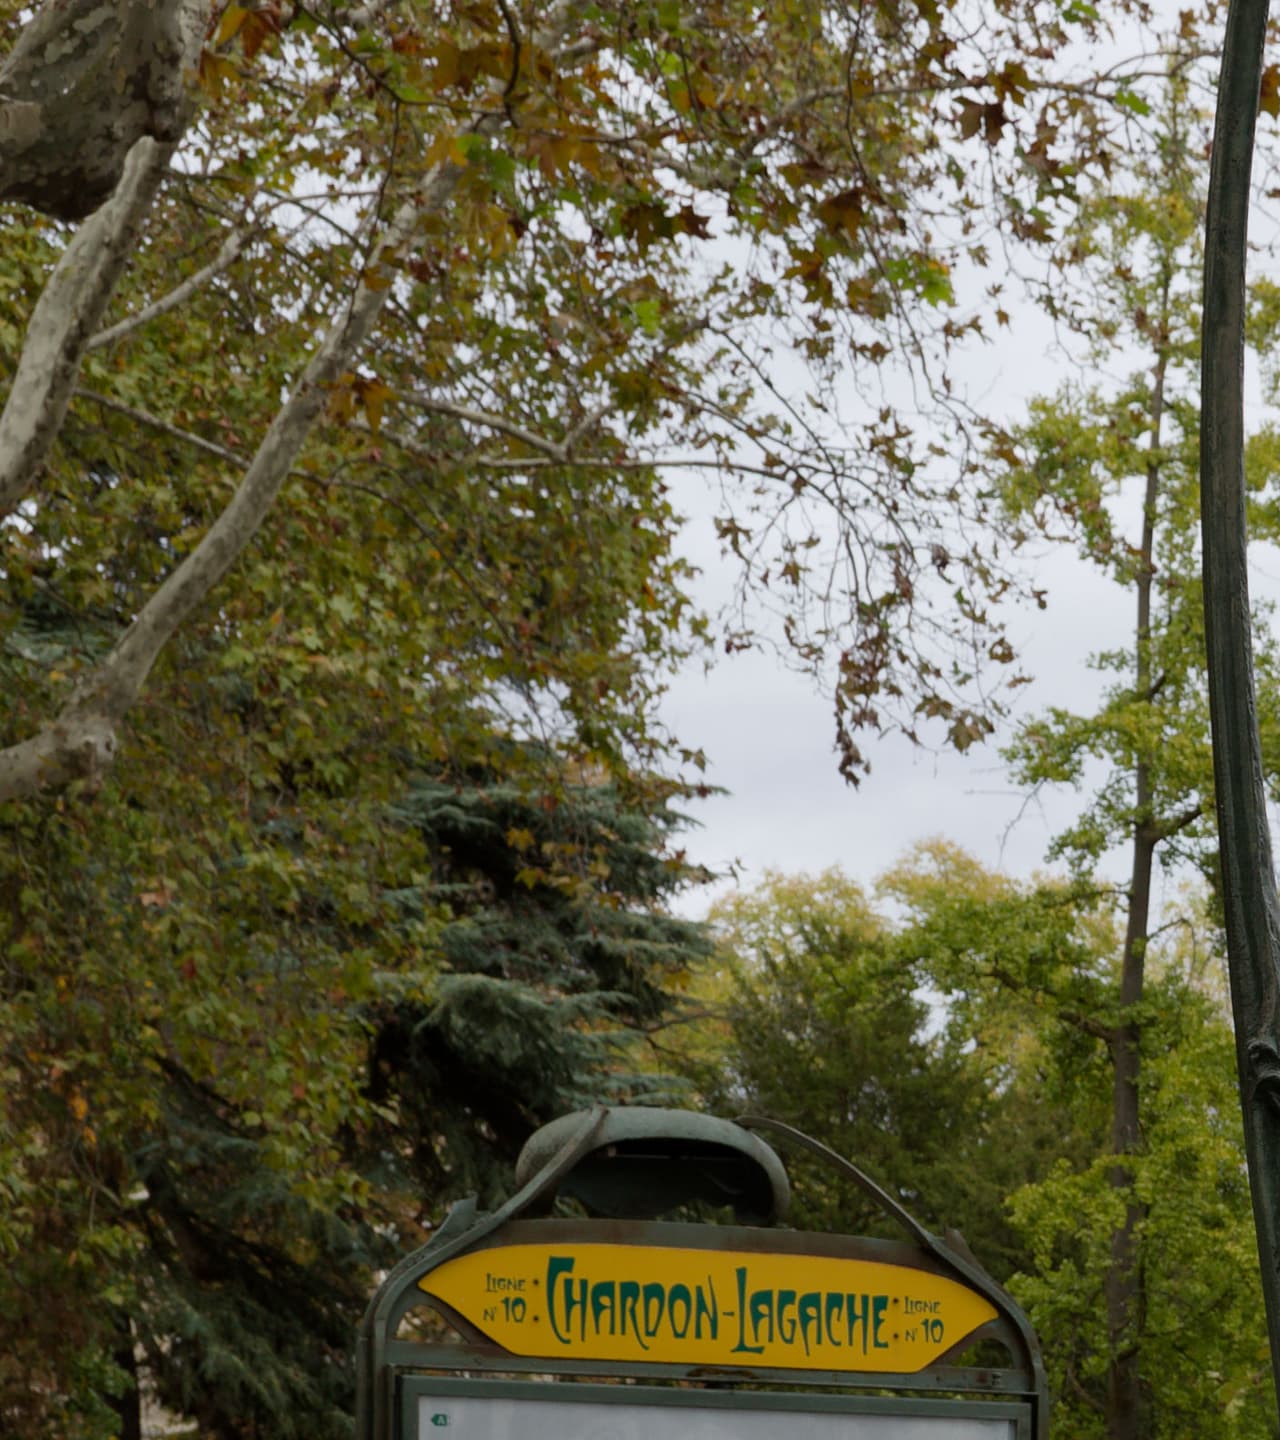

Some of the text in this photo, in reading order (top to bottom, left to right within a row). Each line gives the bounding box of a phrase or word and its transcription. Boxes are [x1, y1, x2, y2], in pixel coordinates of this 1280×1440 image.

[501, 1296, 526, 1323] 10
[545, 1255, 889, 1357] CHARDON-LAGACHE
[921, 1318, 945, 1344] 10
